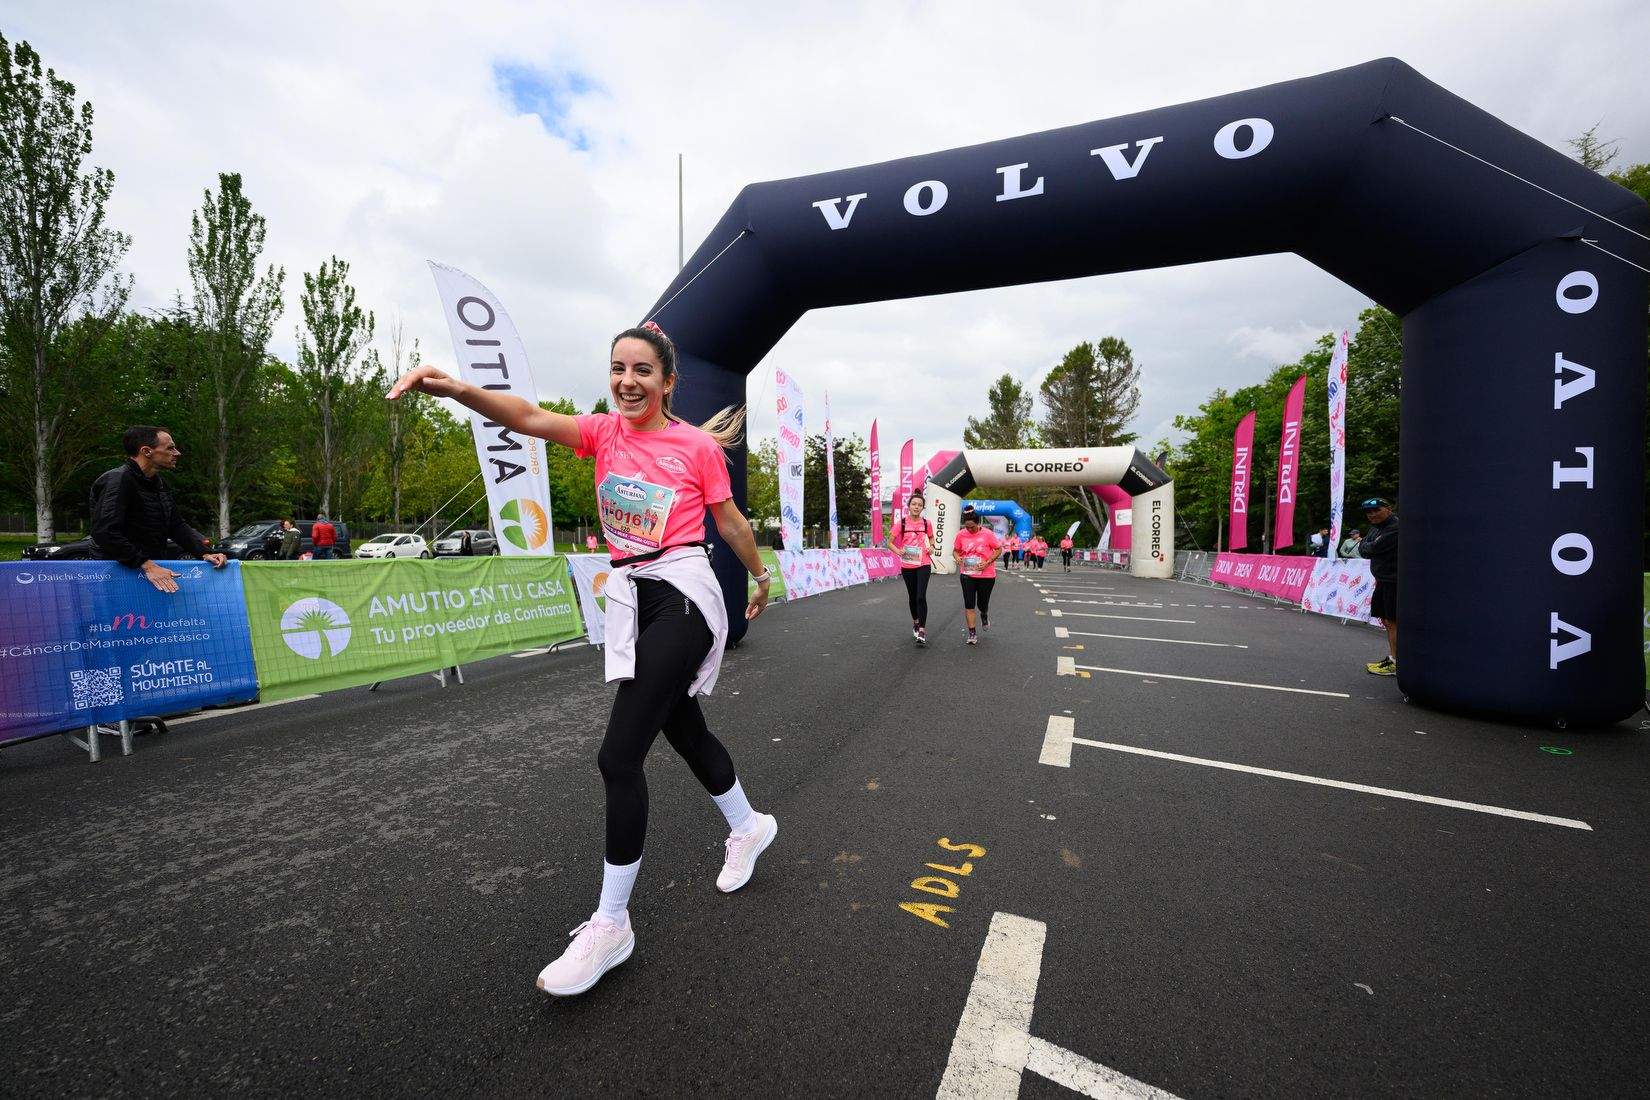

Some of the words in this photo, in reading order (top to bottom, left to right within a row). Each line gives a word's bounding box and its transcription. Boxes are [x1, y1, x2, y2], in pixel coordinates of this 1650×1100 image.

[812, 118, 1275, 230] VOLVO
[1006, 463, 1022, 472] EL
[1024, 462, 1084, 472] CORREO
[1233, 447, 1248, 513] DRUNI
[1550, 271, 1599, 669] VOLVO
[935, 503, 946, 544] CORREO
[1152, 500, 1161, 513] EL
[935, 546, 943, 557] EL
[1152, 514, 1160, 558] CORREO
[38, 571, 111, 581] Daiichi-Sankyo
[368, 589, 466, 618] AMUTIO
[469, 585, 496, 606] EN
[498, 583, 523, 602] TU
[526, 580, 566, 599] CASA
[370, 627, 397, 644] Tu
[402, 614, 491, 644] proveedor
[494, 610, 512, 625] de
[514, 602, 572, 621] Confianza
[0, 632, 210, 658] #CáncerDeMamaMetastásico
[130, 659, 194, 679] SÚMATE
[196, 660, 212, 671] AL
[131, 672, 213, 692] MOVIMIENTO
[898, 837, 987, 929] ADLS
